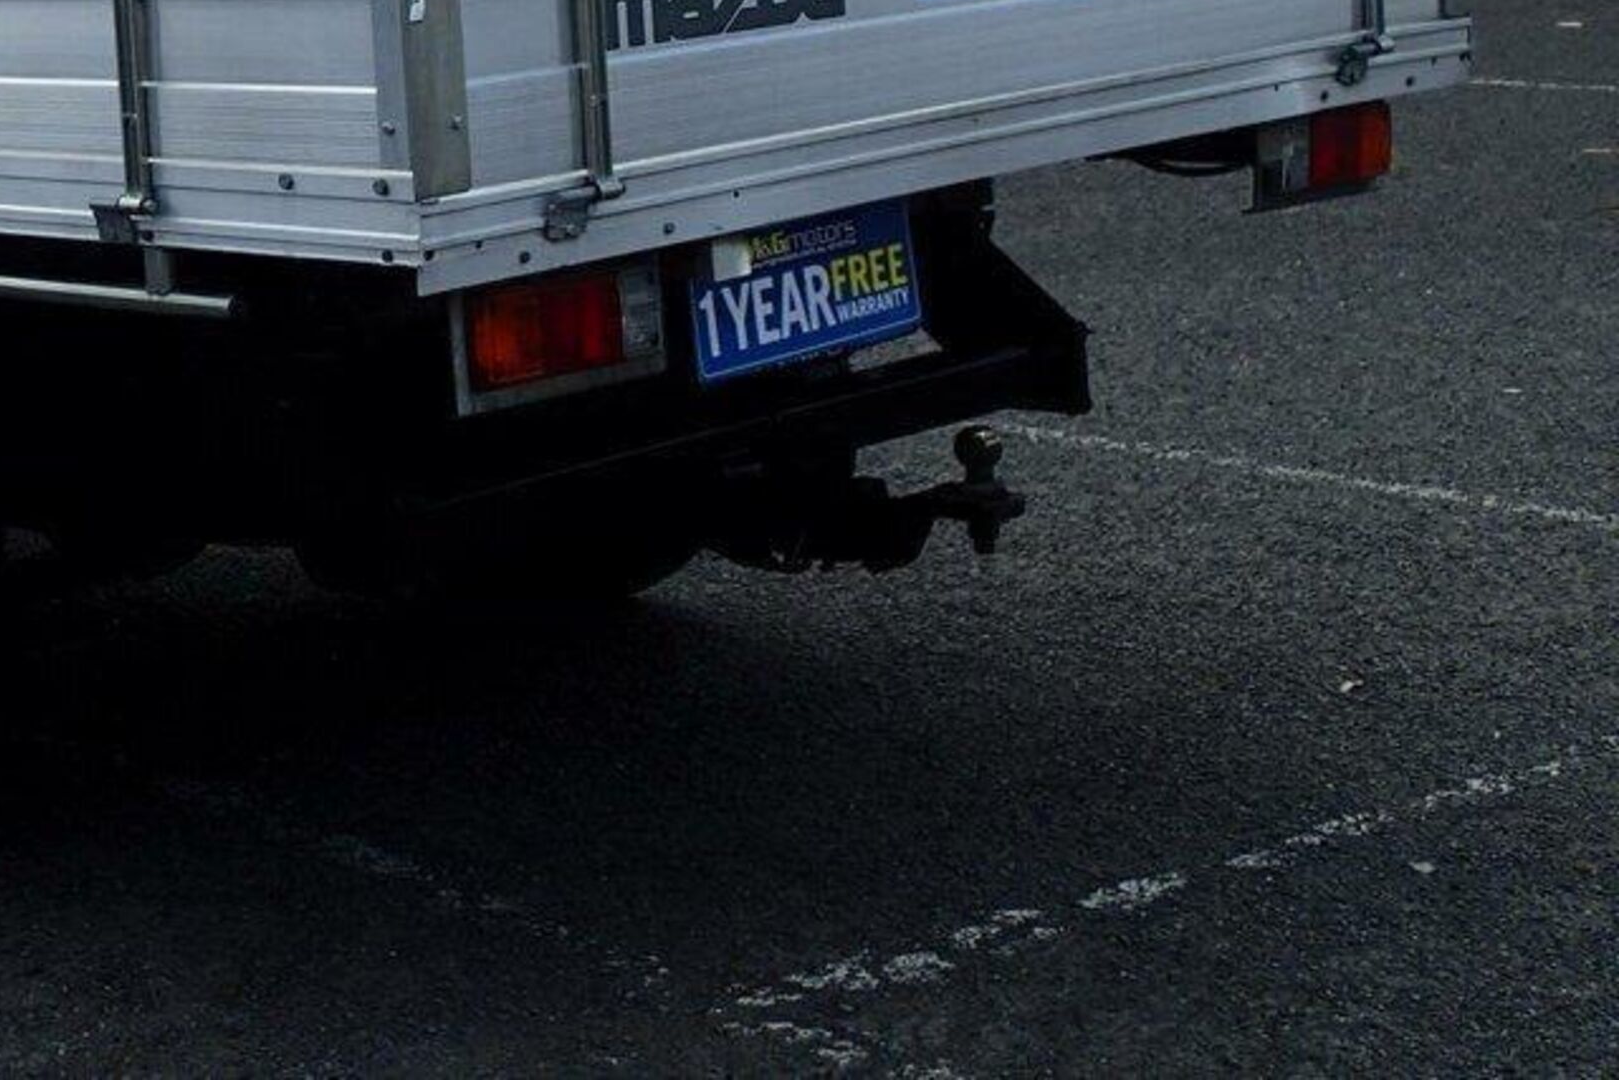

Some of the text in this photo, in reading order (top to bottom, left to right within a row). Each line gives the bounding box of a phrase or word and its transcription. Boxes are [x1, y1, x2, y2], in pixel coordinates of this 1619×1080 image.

[829, 241, 909, 301] FREE
[698, 264, 837, 357] 1 YEAR
[836, 286, 911, 324] WARRANTY
